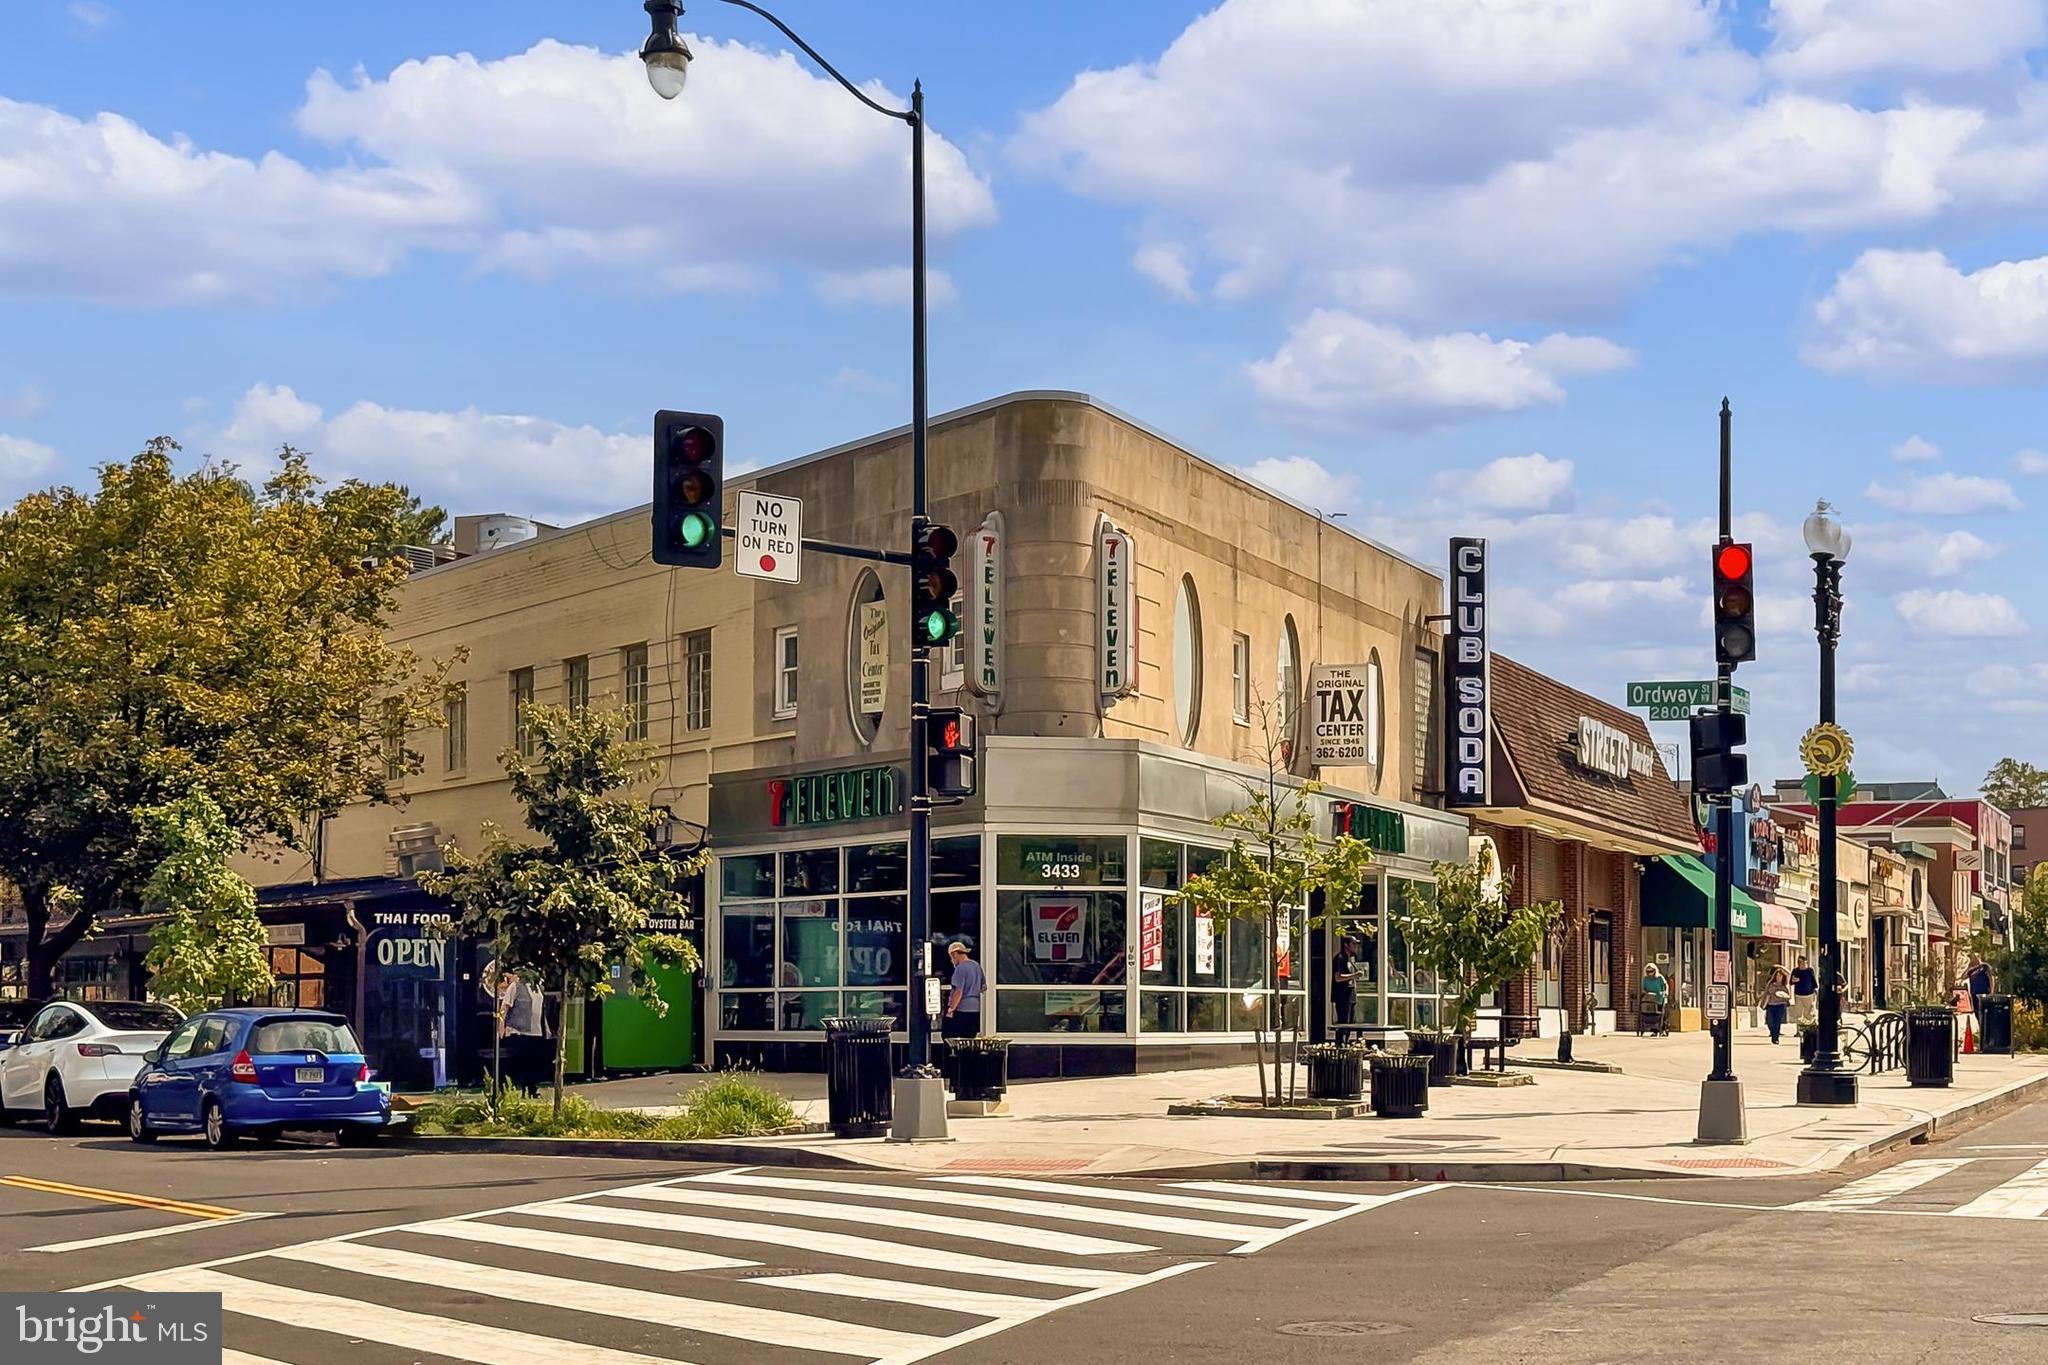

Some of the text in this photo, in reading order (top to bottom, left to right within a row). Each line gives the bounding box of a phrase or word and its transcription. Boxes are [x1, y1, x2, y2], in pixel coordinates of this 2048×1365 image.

[756, 500, 783, 518] NO
[751, 518, 787, 536] TURN
[742, 535, 794, 554] ON RED
[1457, 546, 1483, 663] CLUB
[862, 661, 884, 677] Center
[1330, 670, 1351, 679] THE
[1316, 679, 1364, 688] ORIGINAL
[1632, 685, 1699, 704] Ordway
[1316, 689, 1364, 722] TAX
[1650, 706, 1690, 719] 2800
[1316, 724, 1364, 737] CENTER
[1457, 677, 1484, 794] SODA
[1580, 717, 1630, 778] STREETS
[1026, 852, 1093, 863] ATM Inside
[1041, 864, 1080, 878] 3433
[374, 913, 450, 925] THAI FOOD
[649, 919, 677, 929] OYSTER
[679, 919, 694, 930] BAR
[377, 938, 447, 968] OPEN
